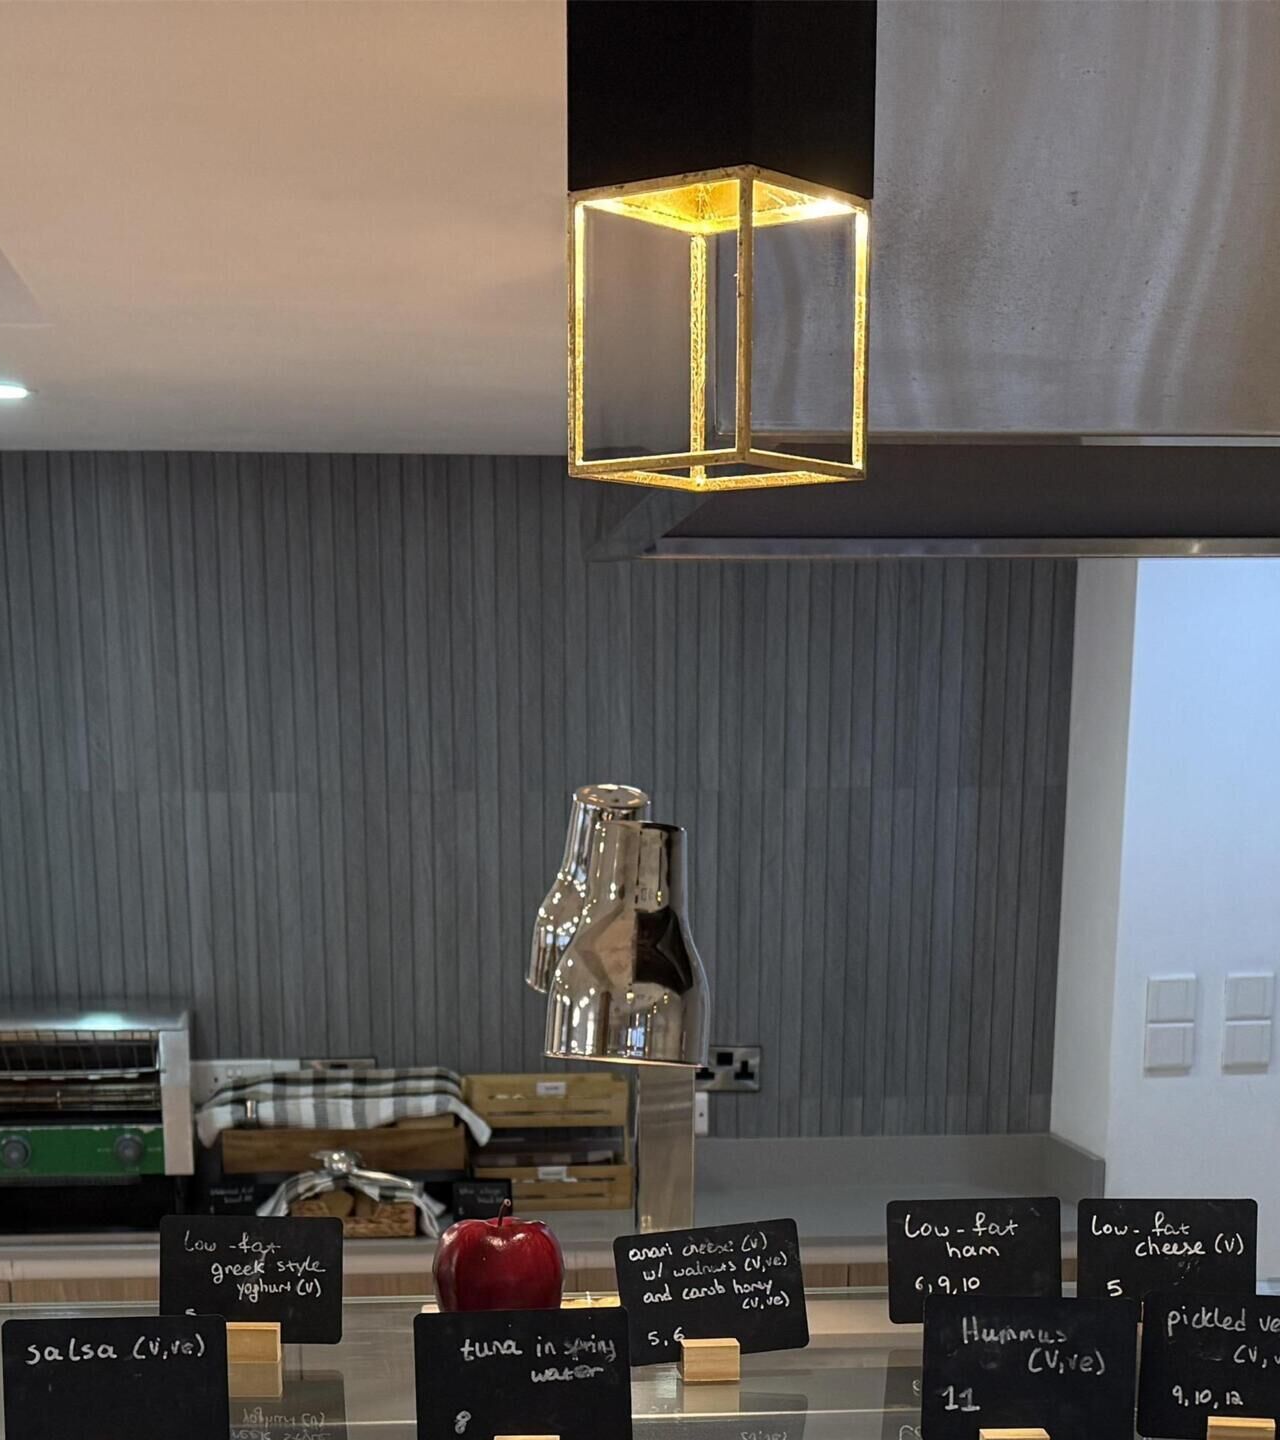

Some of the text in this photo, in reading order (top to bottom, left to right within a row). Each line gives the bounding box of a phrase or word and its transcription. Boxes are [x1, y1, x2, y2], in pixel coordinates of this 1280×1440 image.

[628, 1242, 673, 1261] anari
[945, 1241, 1000, 1259] ham
[1135, 1236, 1206, 1257] cheese
[211, 1256, 326, 1284] greek style
[642, 1261, 663, 1281] w/
[673, 1260, 737, 1278] walnuts
[237, 1278, 291, 1303] yoghurt
[643, 1278, 773, 1303] and carob honey
[1107, 1279, 1123, 1297] 5
[962, 1315, 1068, 1344] Hummus
[1167, 1305, 1247, 1337] pickled
[25, 1337, 118, 1365] salsa
[460, 1333, 617, 1363] tuna in spring
[531, 1364, 604, 1383] water
[941, 1385, 981, 1412] 11
[454, 1410, 472, 1434] 8
